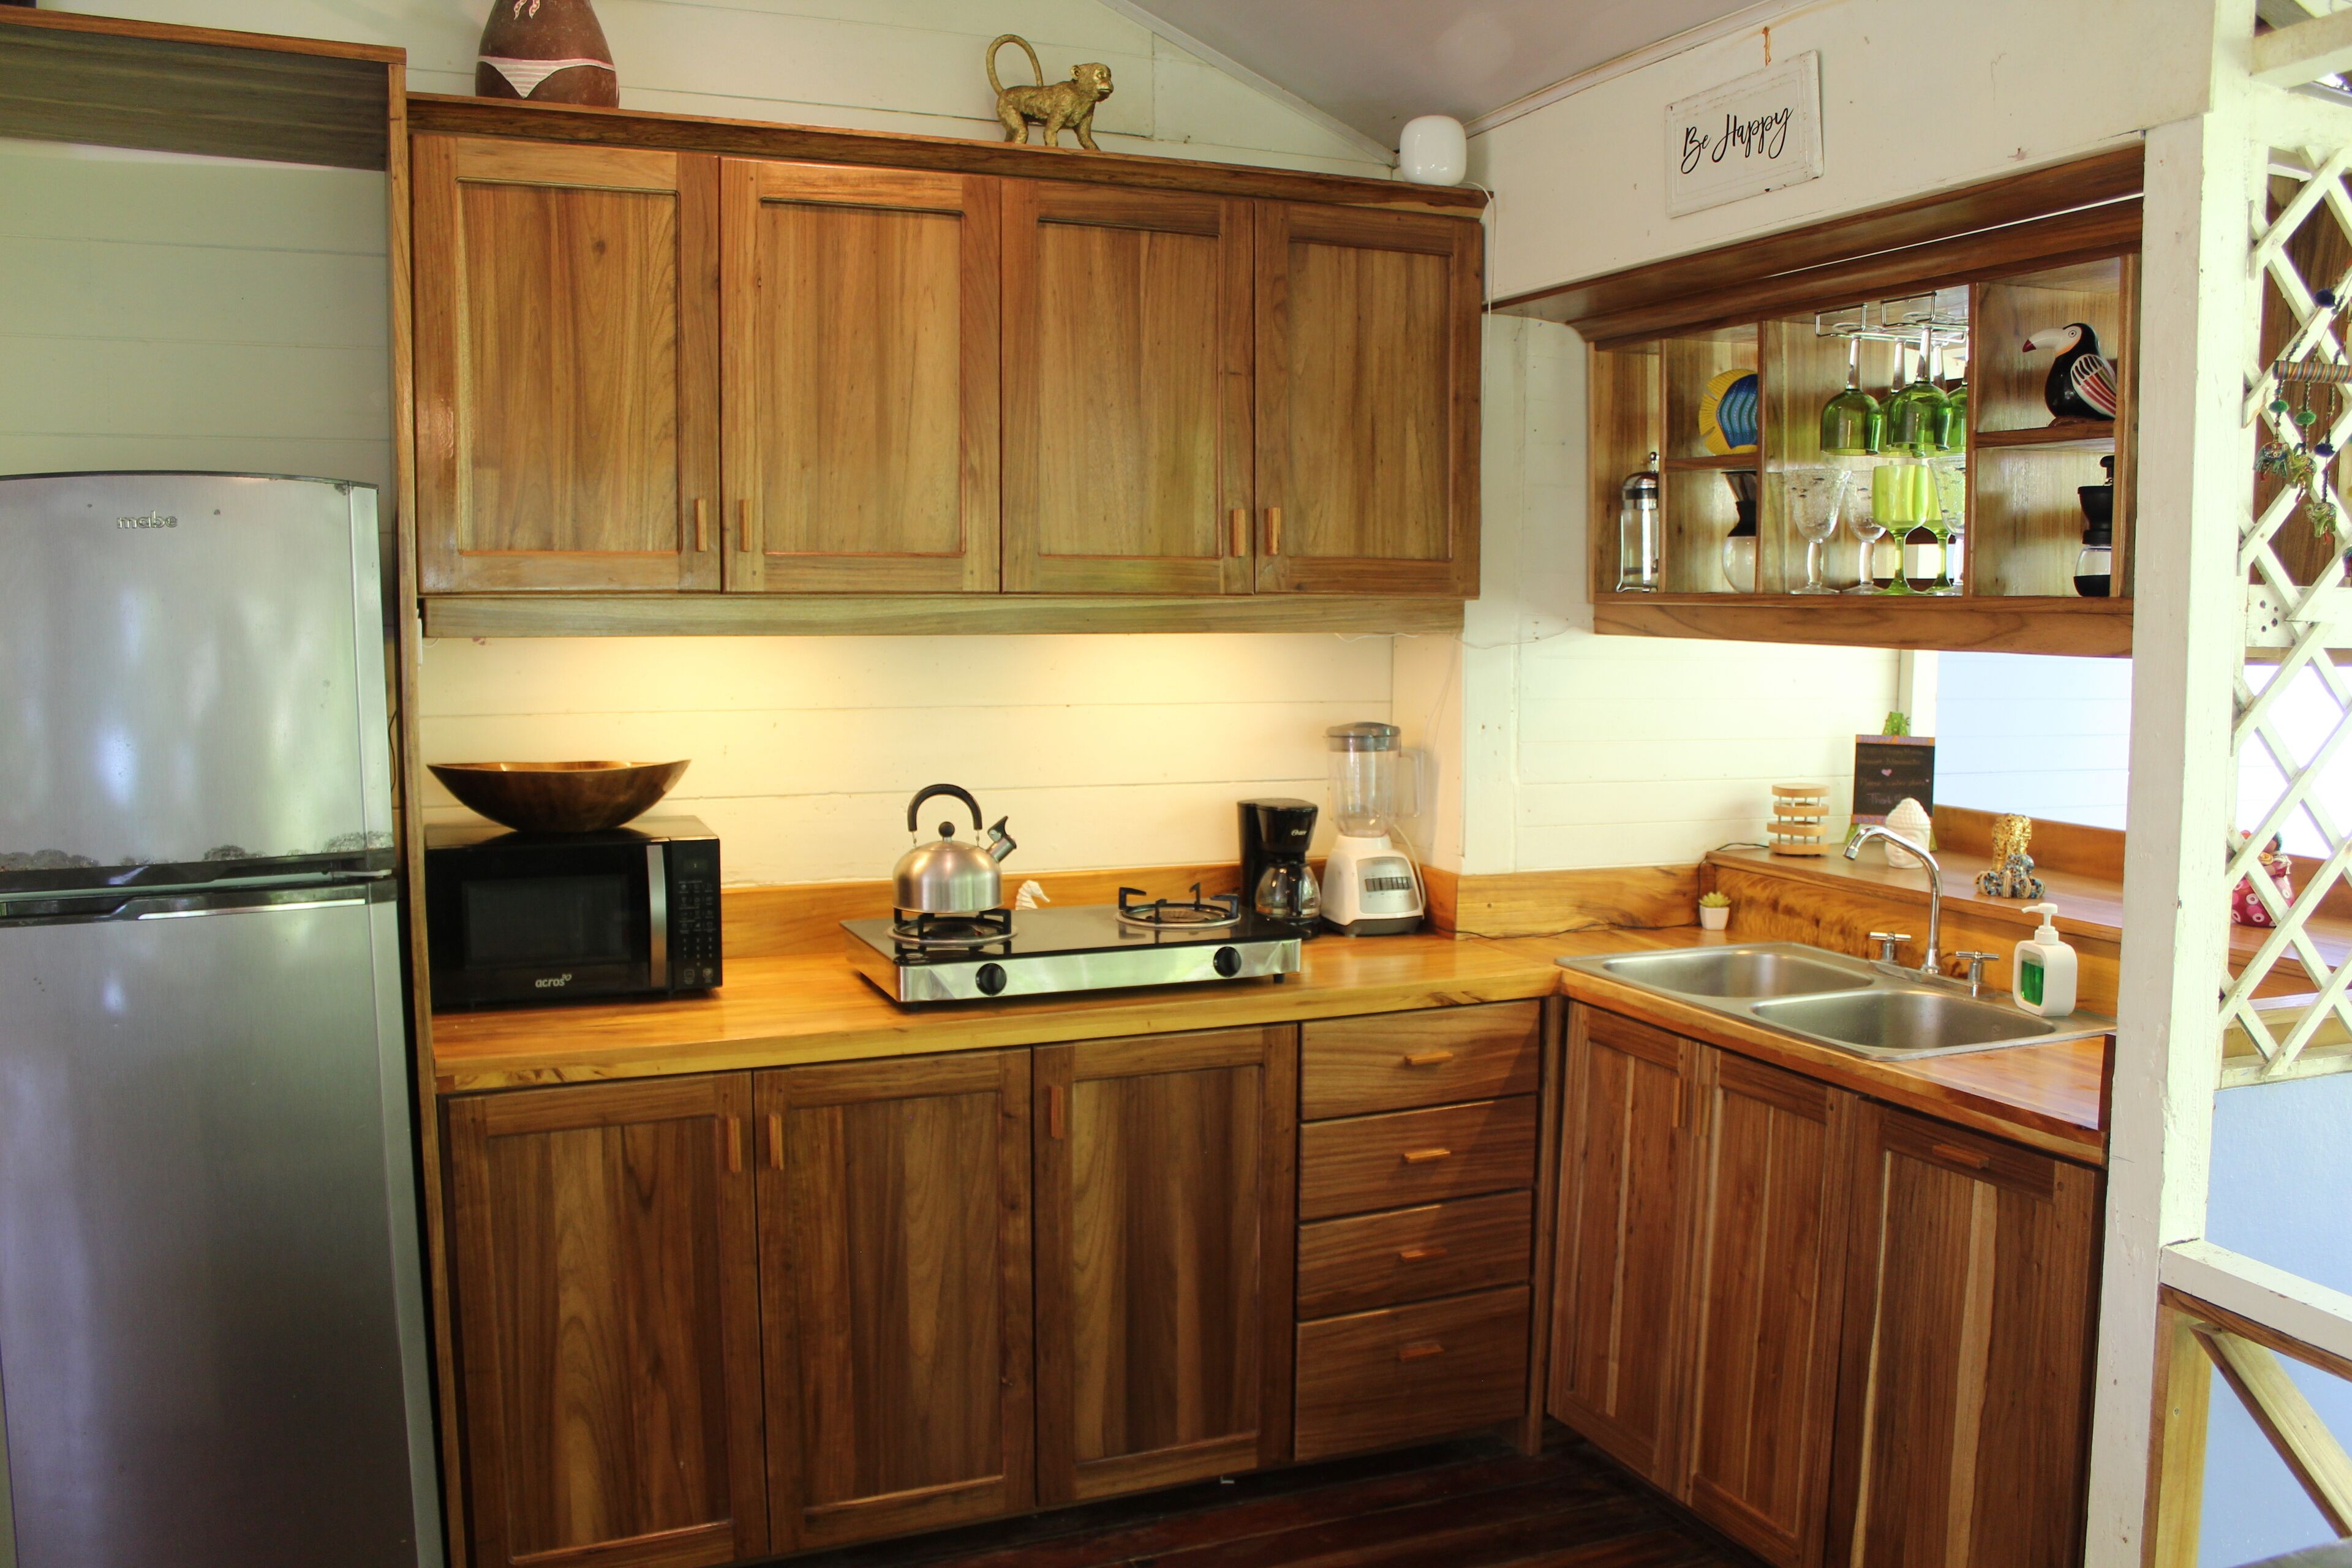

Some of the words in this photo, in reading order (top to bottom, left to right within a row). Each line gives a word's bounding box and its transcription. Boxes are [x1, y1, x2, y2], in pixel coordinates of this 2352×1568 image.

[1681, 126, 1711, 175] Be
[1711, 107, 1794, 163] Happy
[117, 510, 178, 529] mabe
[535, 979, 565, 988] acros
